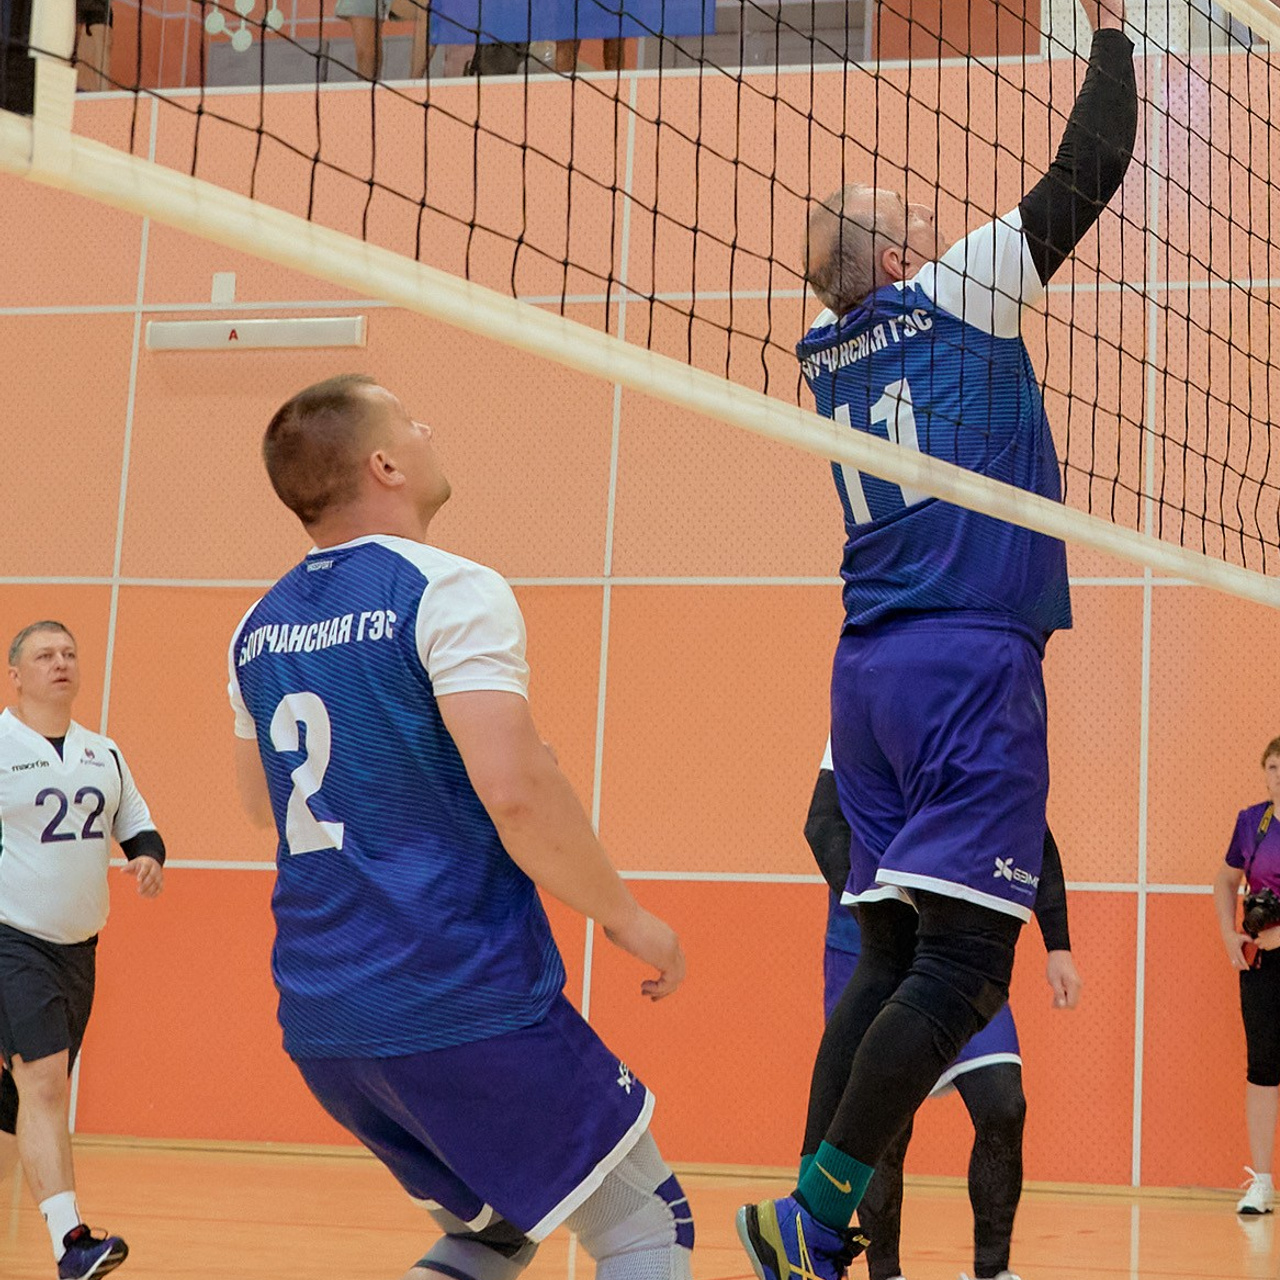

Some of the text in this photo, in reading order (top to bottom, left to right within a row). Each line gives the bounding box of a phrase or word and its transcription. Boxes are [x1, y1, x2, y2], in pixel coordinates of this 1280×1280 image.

[239, 613, 354, 667] БОГУЧАНСКАЯ
[270, 691, 344, 856] 2
[35, 786, 106, 844] 22
